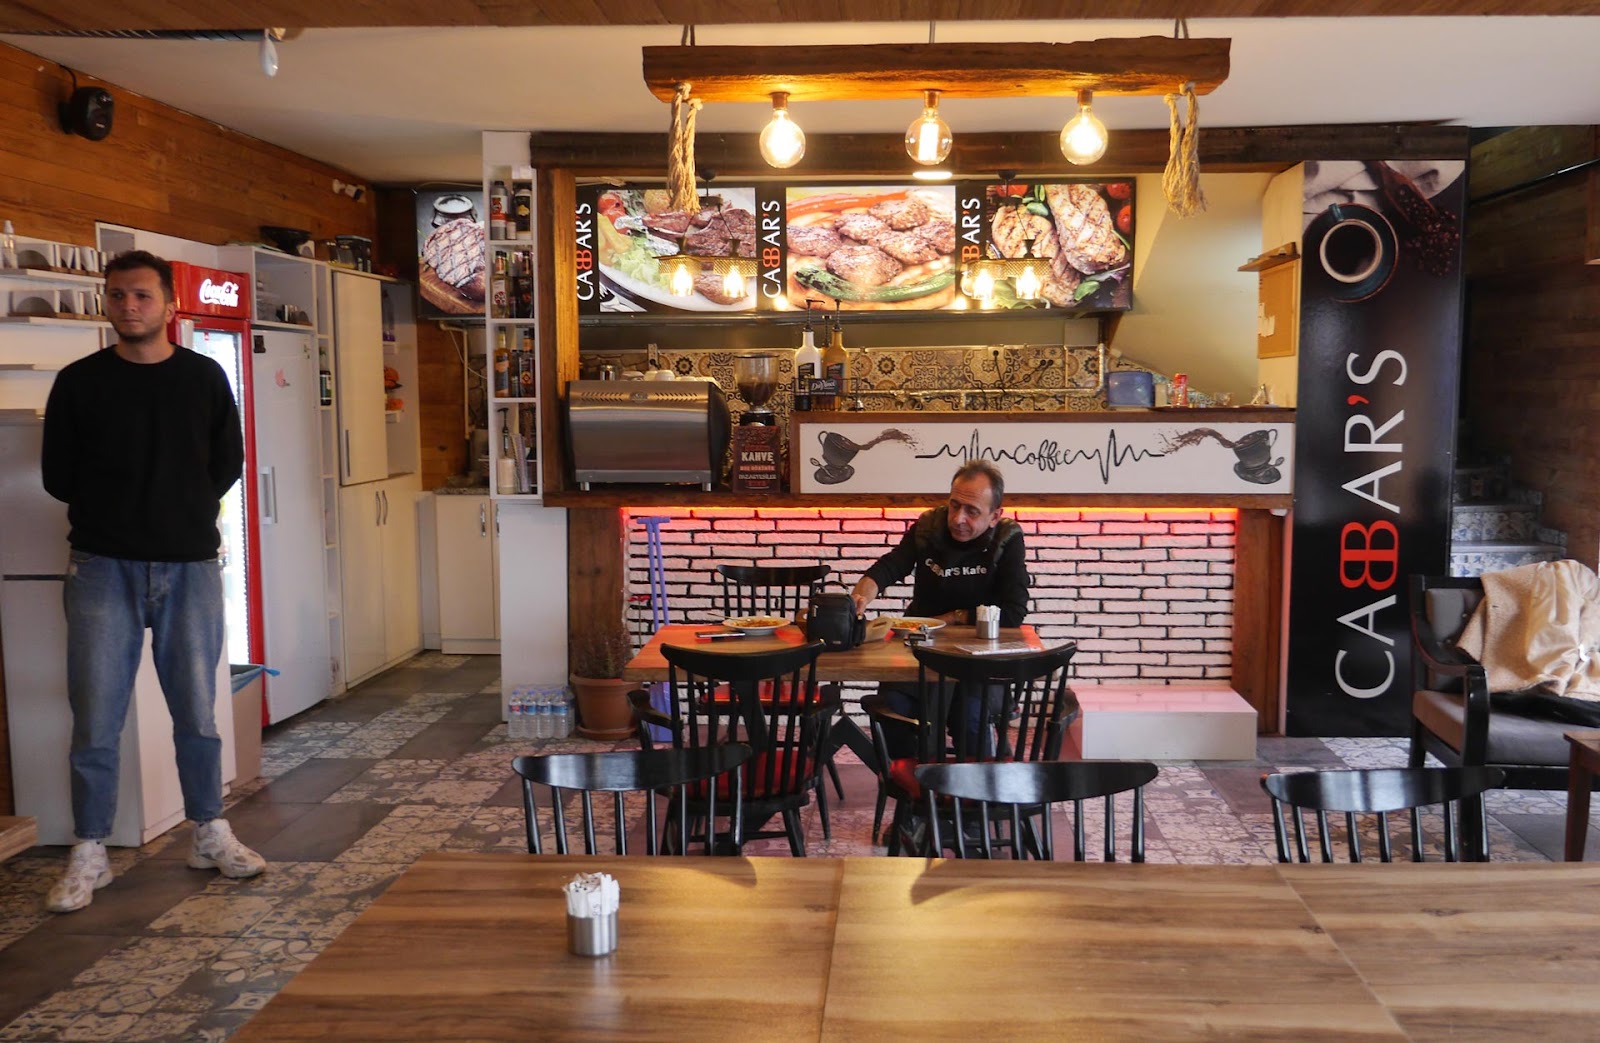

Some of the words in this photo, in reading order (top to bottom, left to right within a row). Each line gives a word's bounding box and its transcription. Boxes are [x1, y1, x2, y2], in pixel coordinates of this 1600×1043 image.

[762, 201, 781, 298] CABBAR'S
[962, 565, 987, 576] Kafe
[1335, 349, 1408, 699] CABBAR'S
